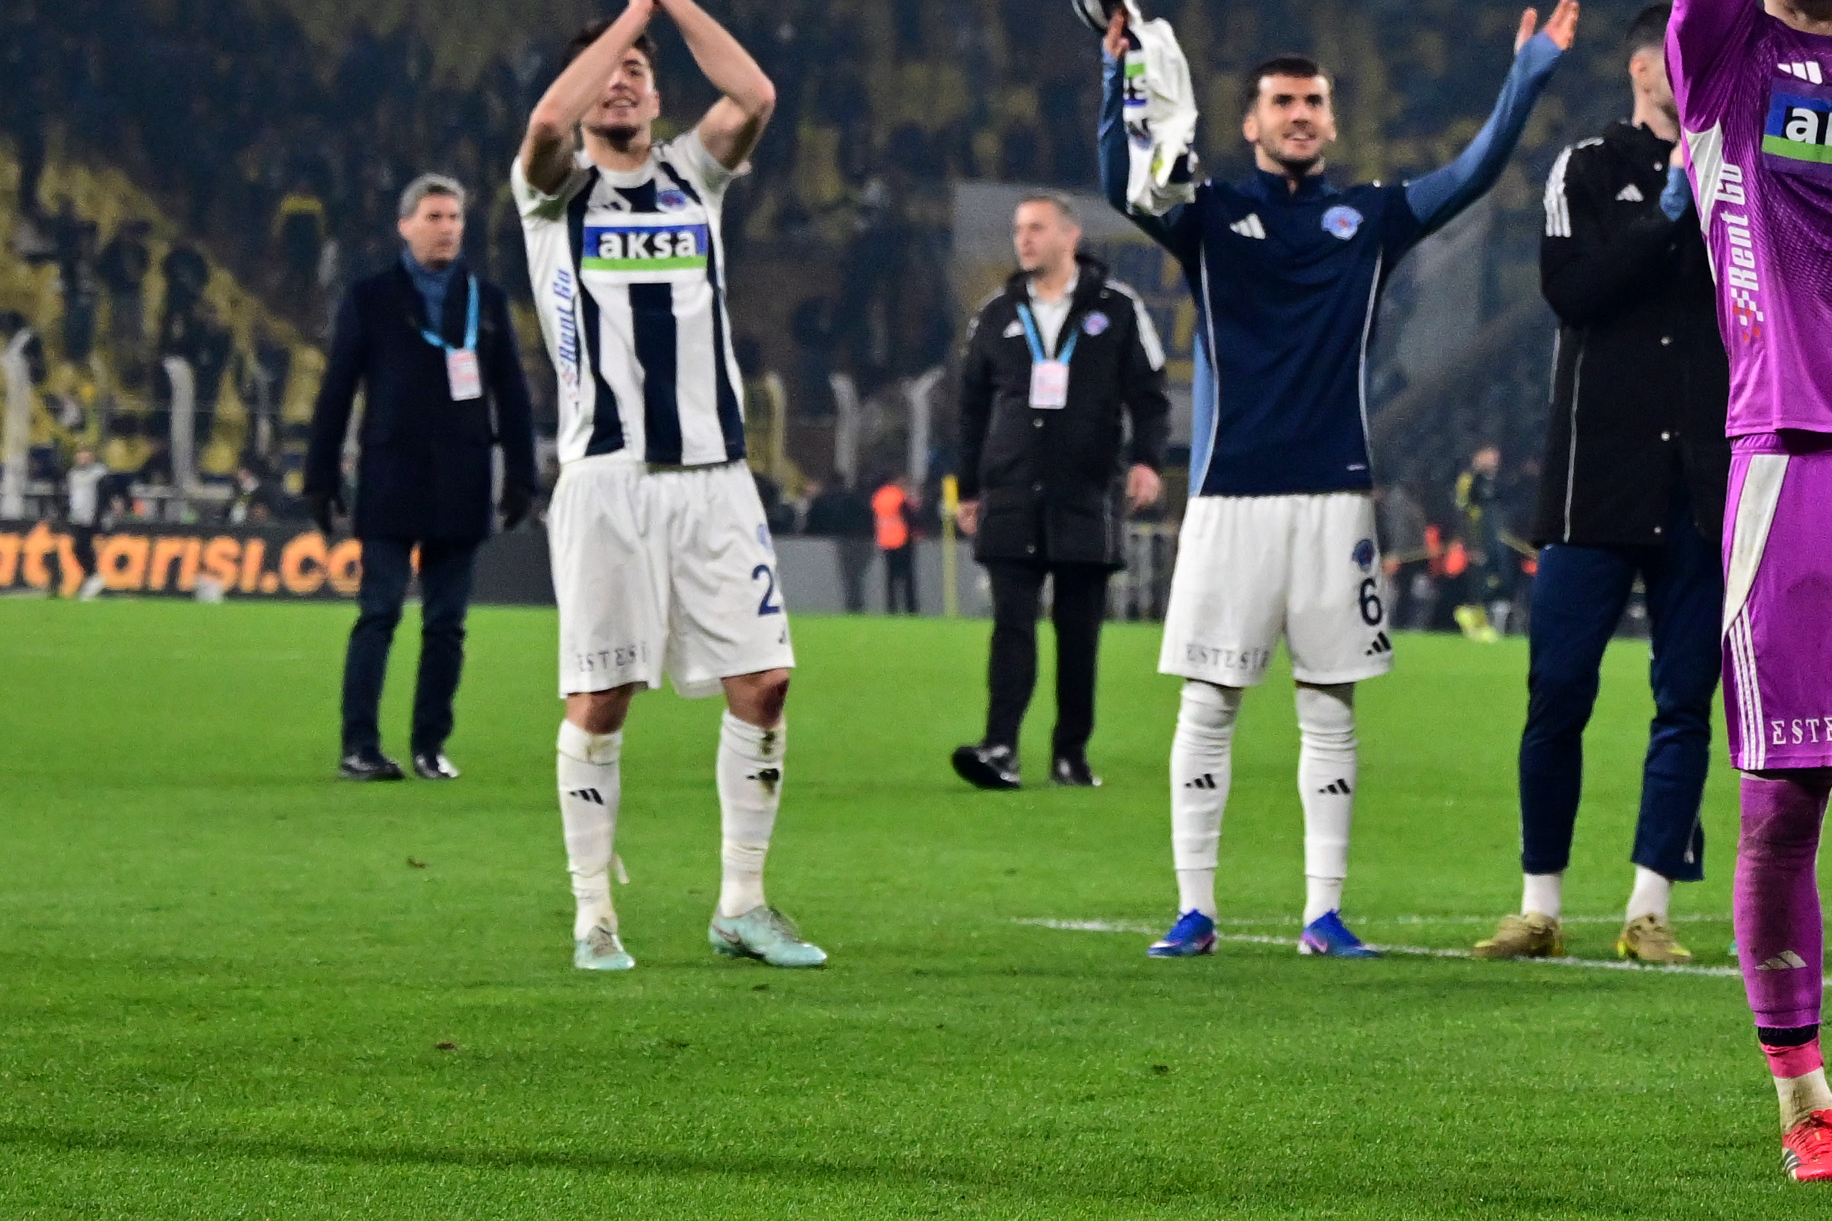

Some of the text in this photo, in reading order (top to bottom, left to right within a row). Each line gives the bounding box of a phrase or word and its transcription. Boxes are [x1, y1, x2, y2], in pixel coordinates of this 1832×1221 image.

[598, 230, 698, 260] aksa
[1720, 210, 1760, 292] Rent
[1359, 578, 1383, 627] 6
